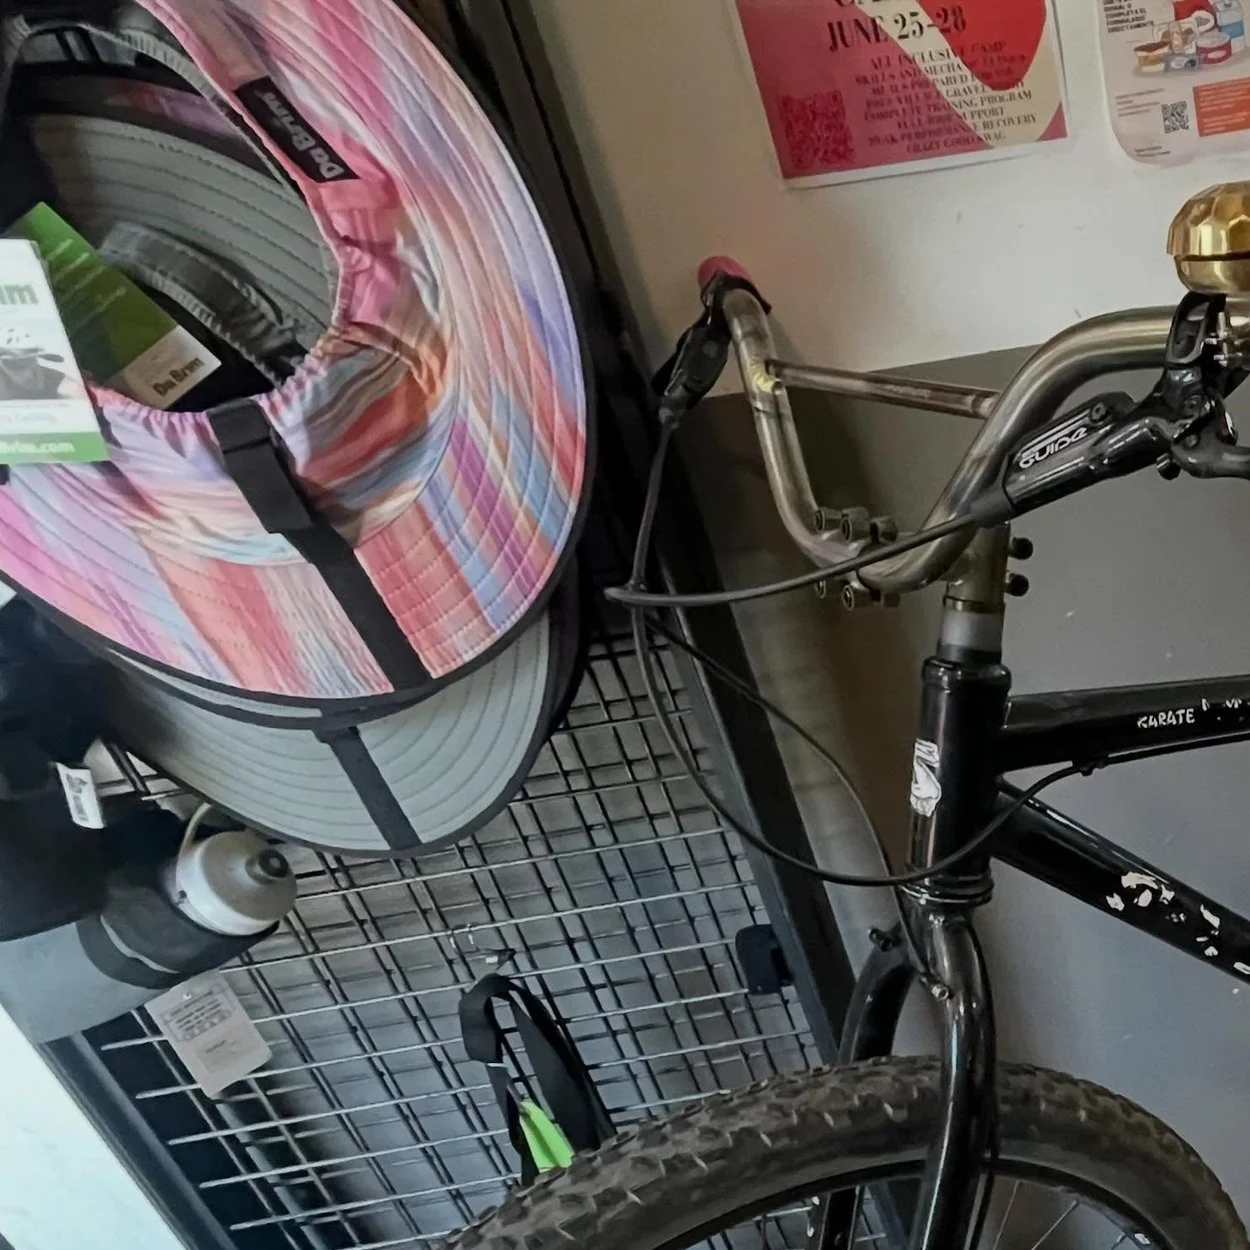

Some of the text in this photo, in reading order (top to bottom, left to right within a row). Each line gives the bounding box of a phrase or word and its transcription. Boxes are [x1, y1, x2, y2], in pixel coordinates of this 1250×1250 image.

[827, 6, 967, 51] JUNE 25-28
[982, 114, 1037, 130] RECOVERY
[309, 147, 345, 180] Da
[152, 382, 177, 397] Da
[1137, 708, 1196, 729] KARATE
